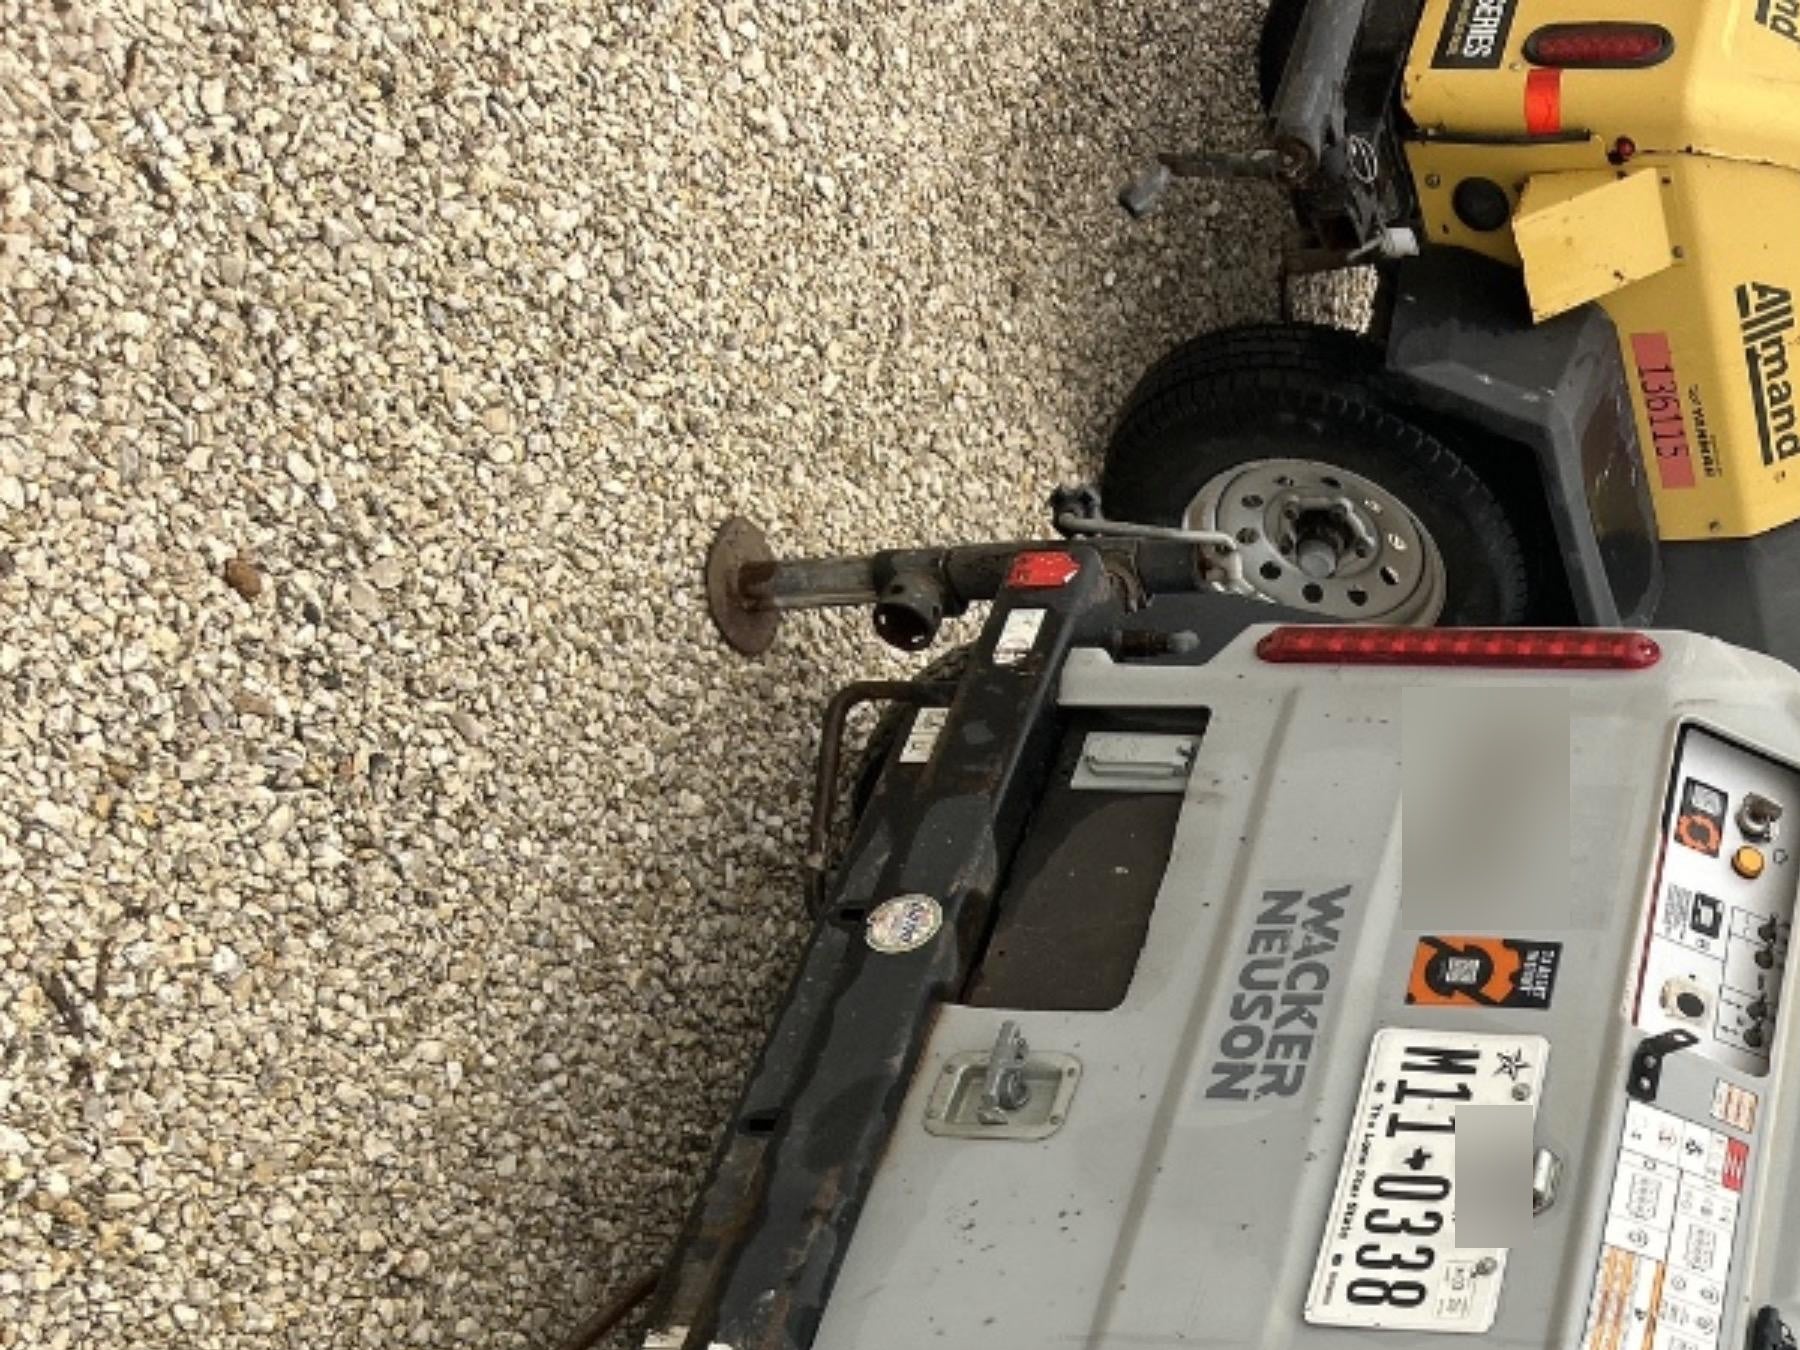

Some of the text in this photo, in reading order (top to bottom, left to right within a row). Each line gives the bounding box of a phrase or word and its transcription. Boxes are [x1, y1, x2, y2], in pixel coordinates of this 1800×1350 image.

[1638, 364, 1690, 459] 136115
[1205, 890, 1304, 1100] NEUSON
[1256, 884, 1353, 1097] WACKER
